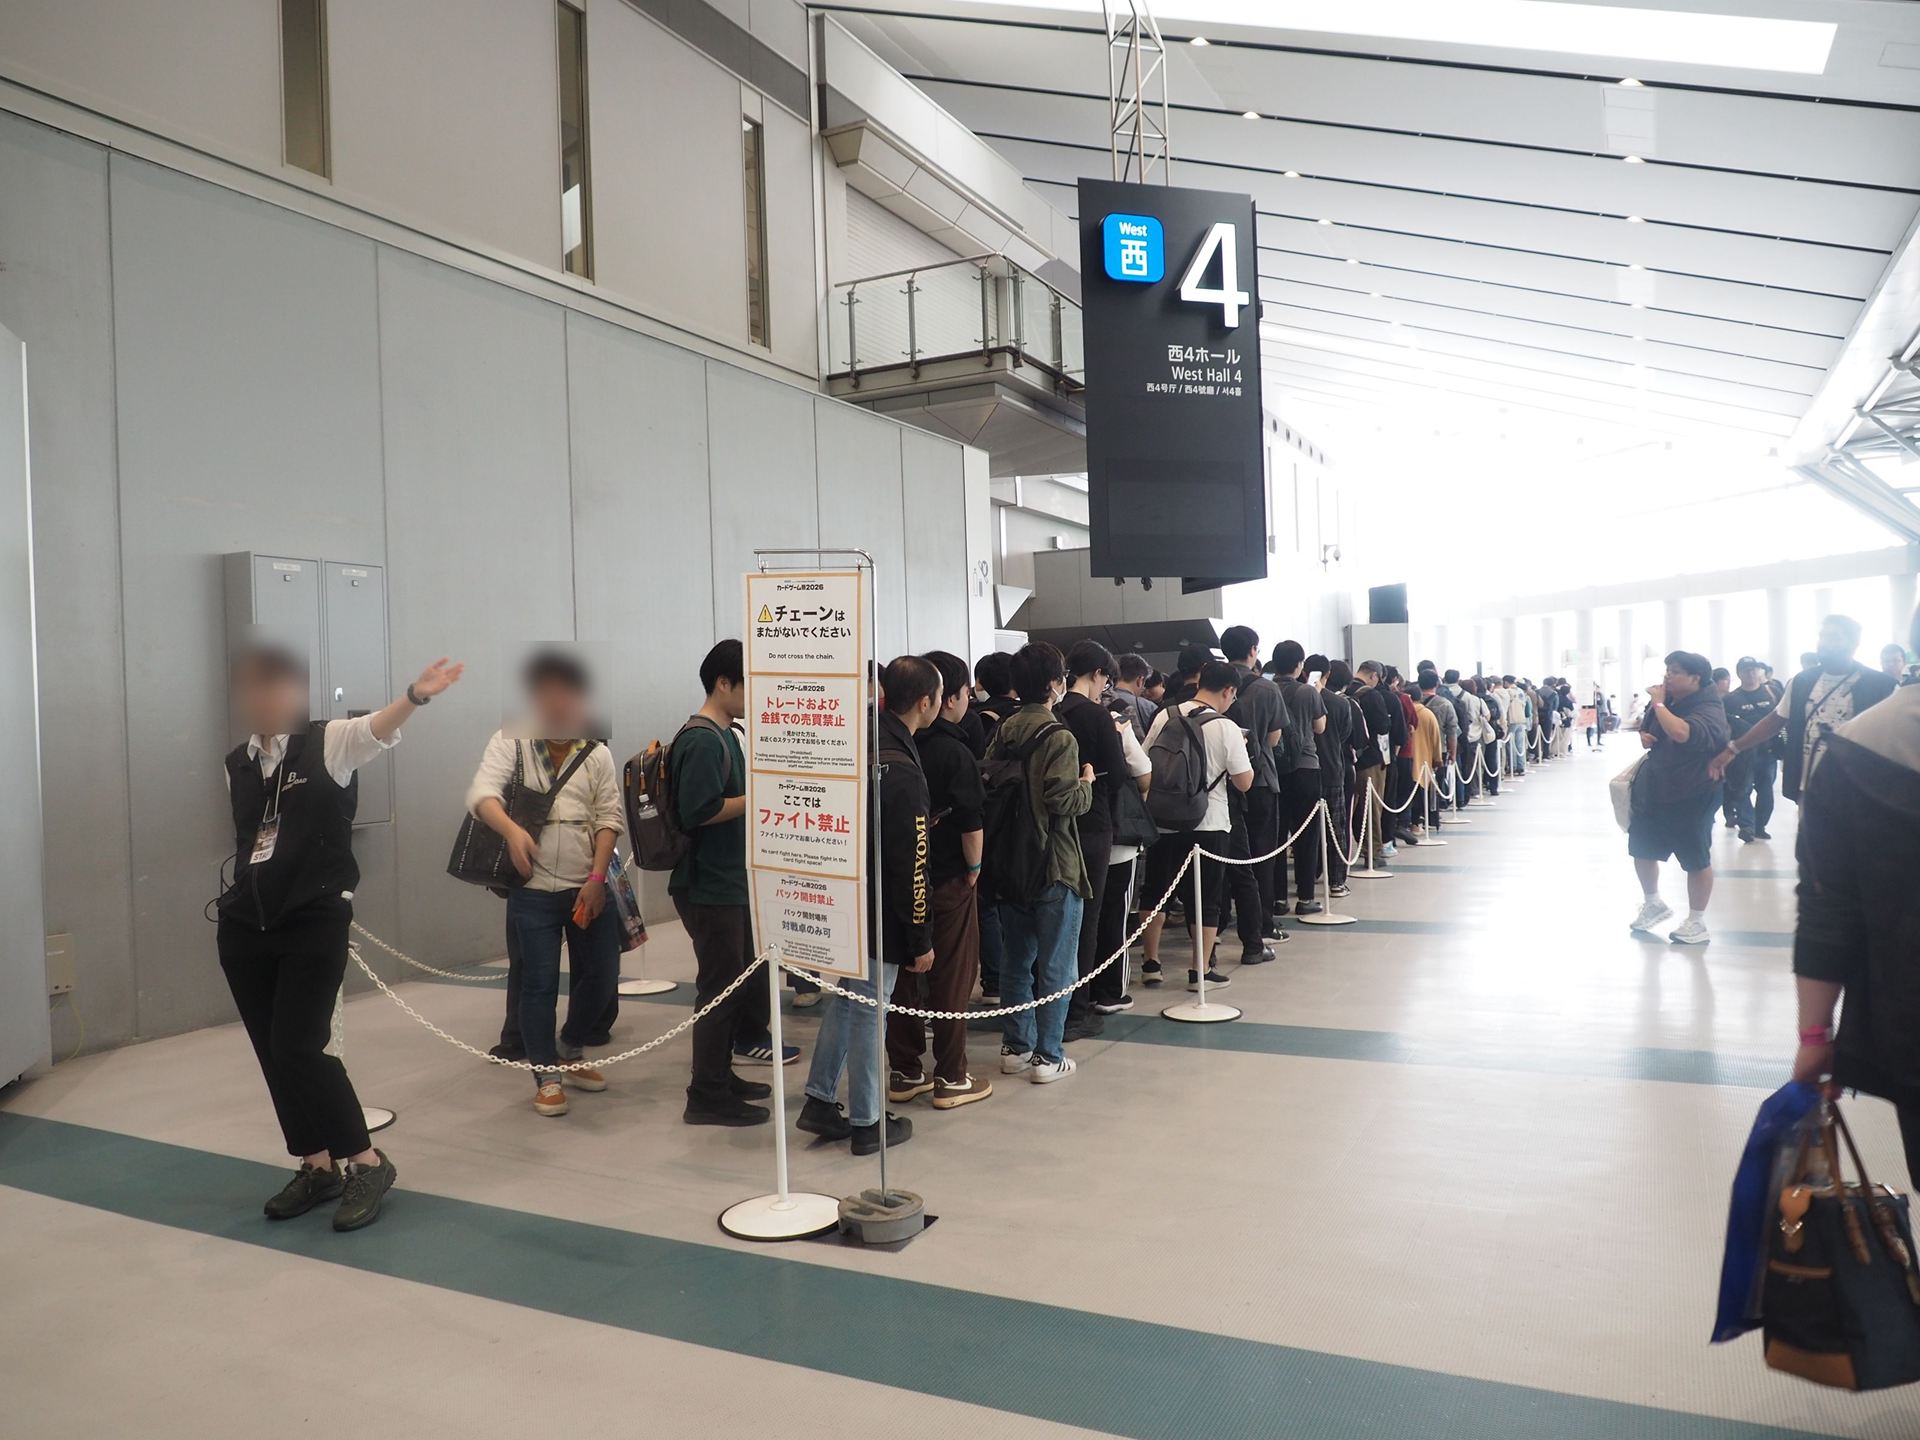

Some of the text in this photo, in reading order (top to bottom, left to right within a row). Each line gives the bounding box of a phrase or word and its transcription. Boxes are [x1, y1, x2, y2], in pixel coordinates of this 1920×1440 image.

[1118, 221, 1148, 237] West
[1120, 239, 1148, 276] 西
[1179, 222, 1249, 328] 4
[1168, 344, 1240, 364] 西4ホール
[1171, 366, 1242, 383] West Hall 4
[775, 605, 845, 622] チェーンは
[756, 626, 851, 638] またがないでください
[815, 652, 835, 660] chain.
[767, 696, 840, 711] トレードおよび
[761, 711, 845, 727] 金銭での売買禁止
[783, 794, 822, 808] ここでは
[759, 808, 850, 834] ファイト禁止
[781, 920, 831, 938] 対戦卓のみ可
